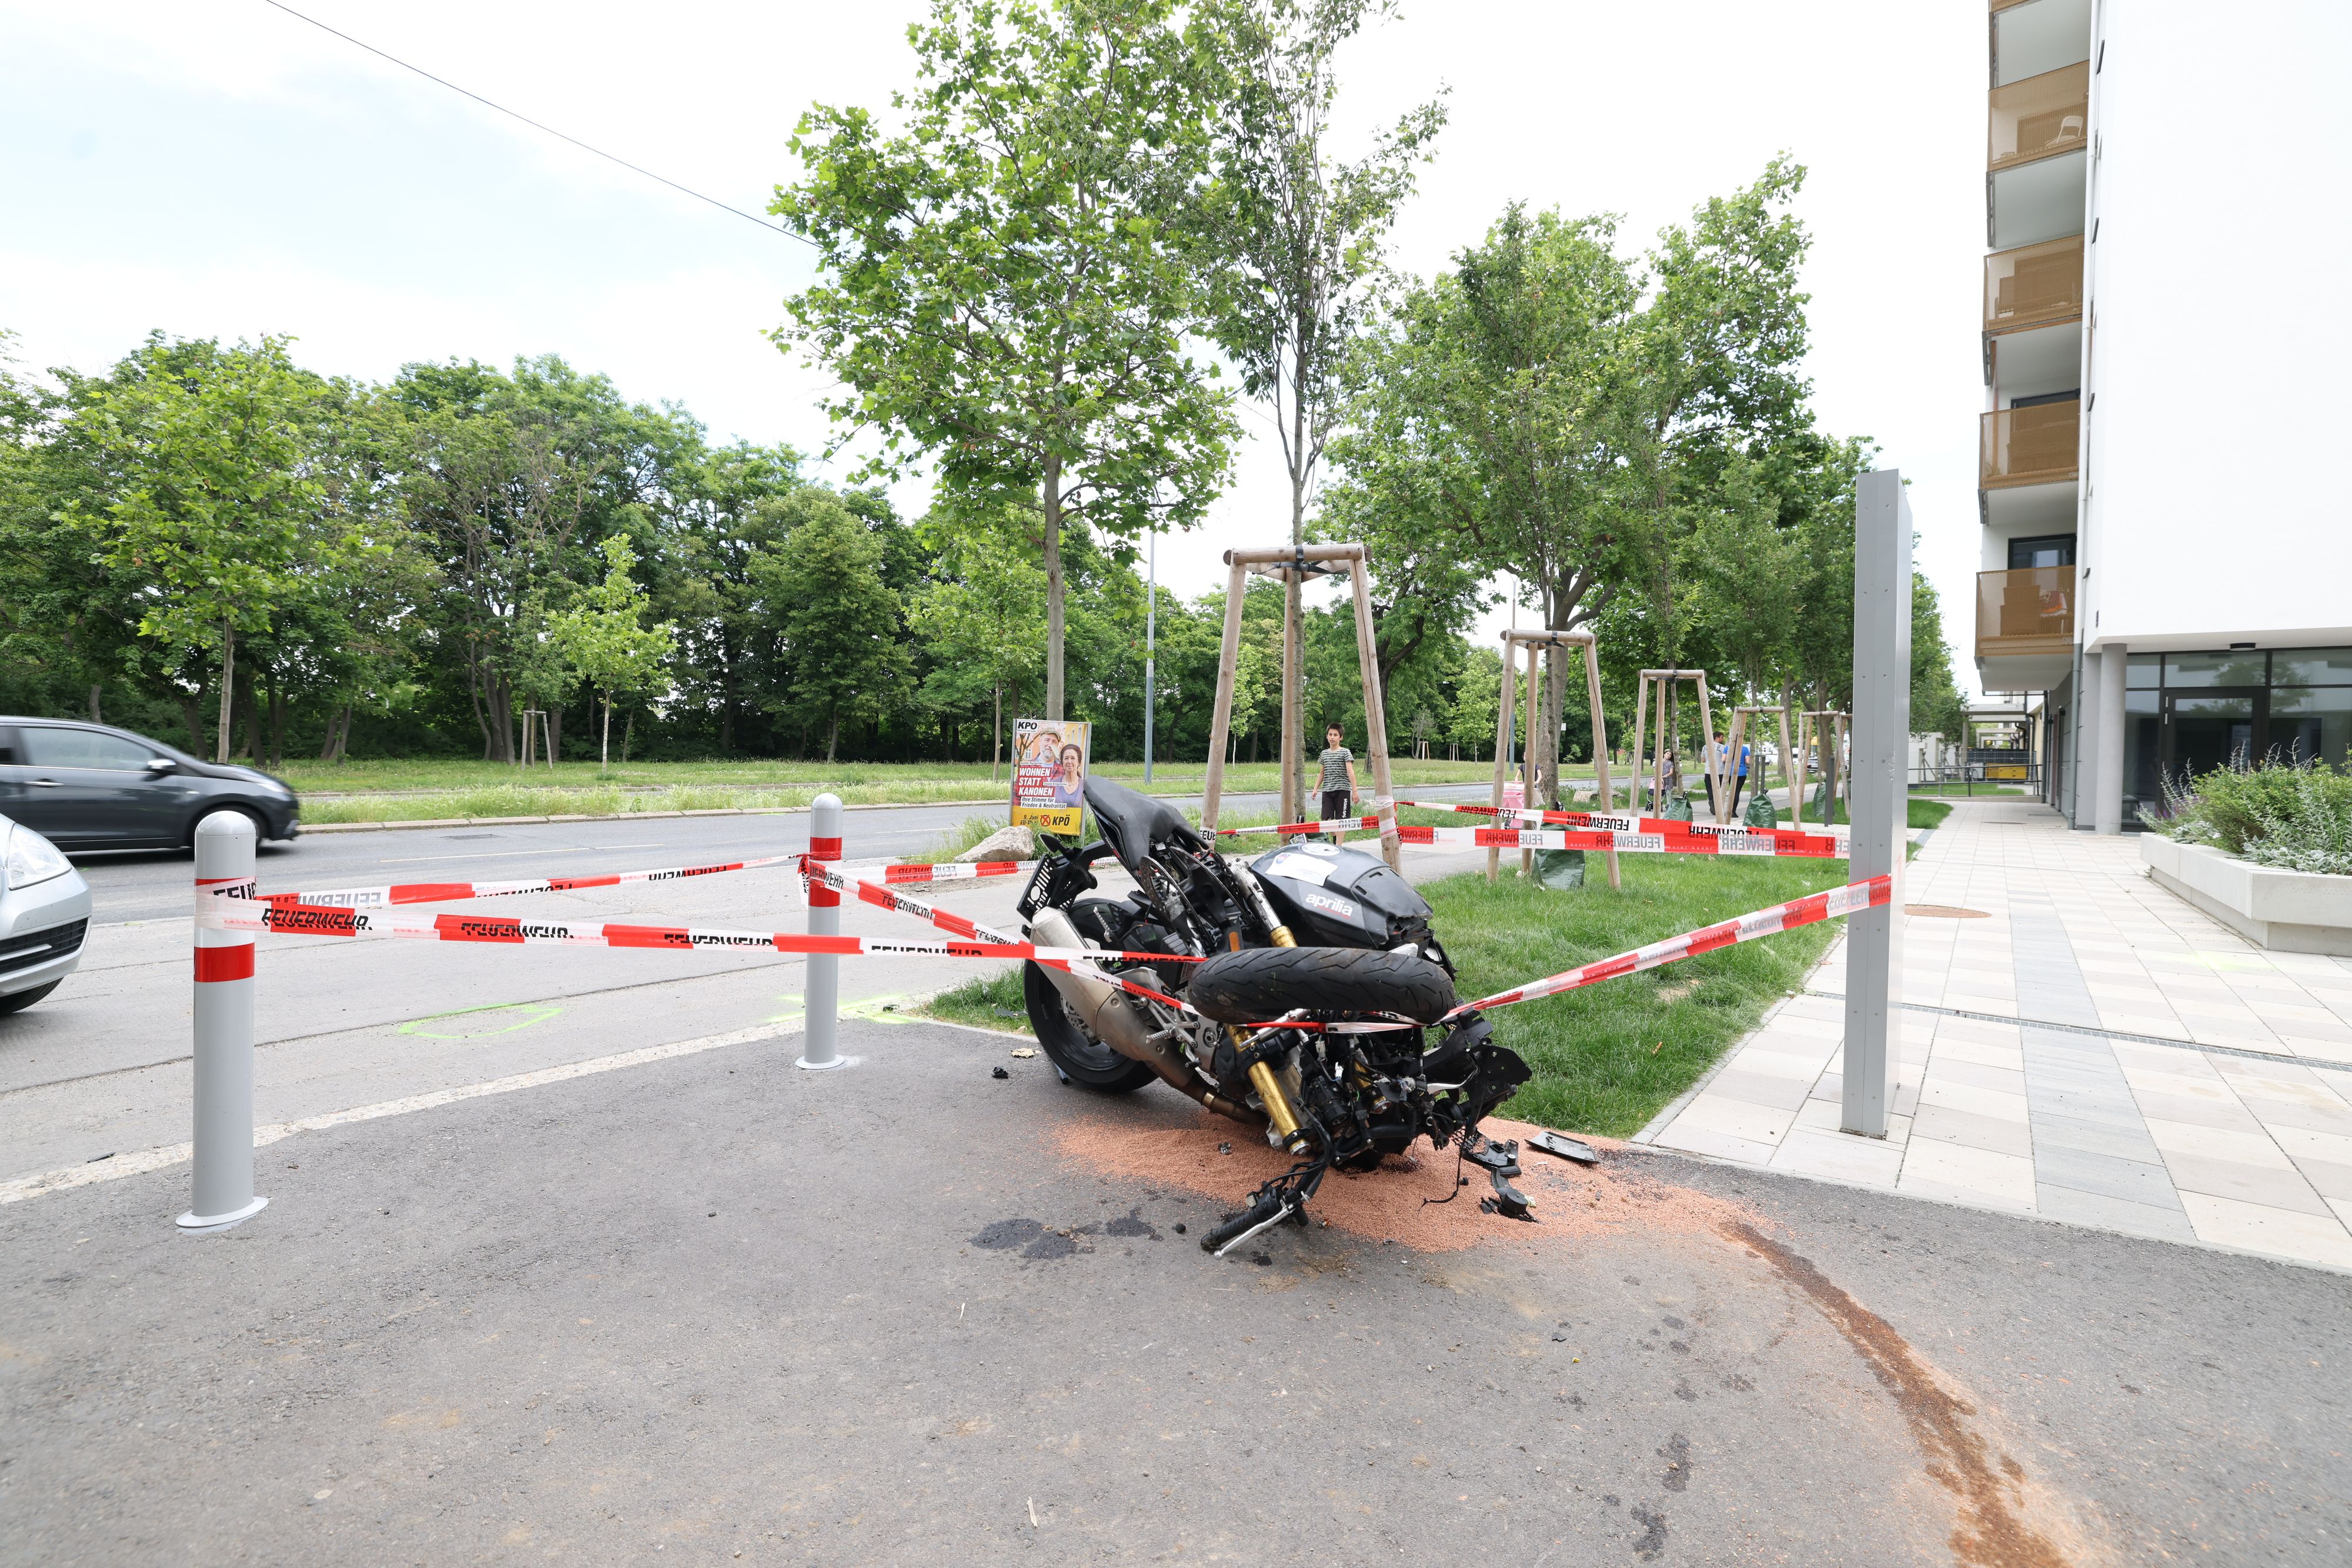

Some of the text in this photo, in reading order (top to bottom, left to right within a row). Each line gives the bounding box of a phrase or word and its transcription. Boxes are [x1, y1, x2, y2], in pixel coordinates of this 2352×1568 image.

[1019, 767, 1051, 777] WOHNEN
[1018, 777, 1041, 786] STATT
[1018, 787, 1053, 796] KANONEN
[1052, 814, 1070, 826] KPÖ
[1566, 815, 1629, 831] FEUERWEHR
[1305, 894, 1353, 917] aprilia
[262, 908, 373, 931] FEUERWEHR
